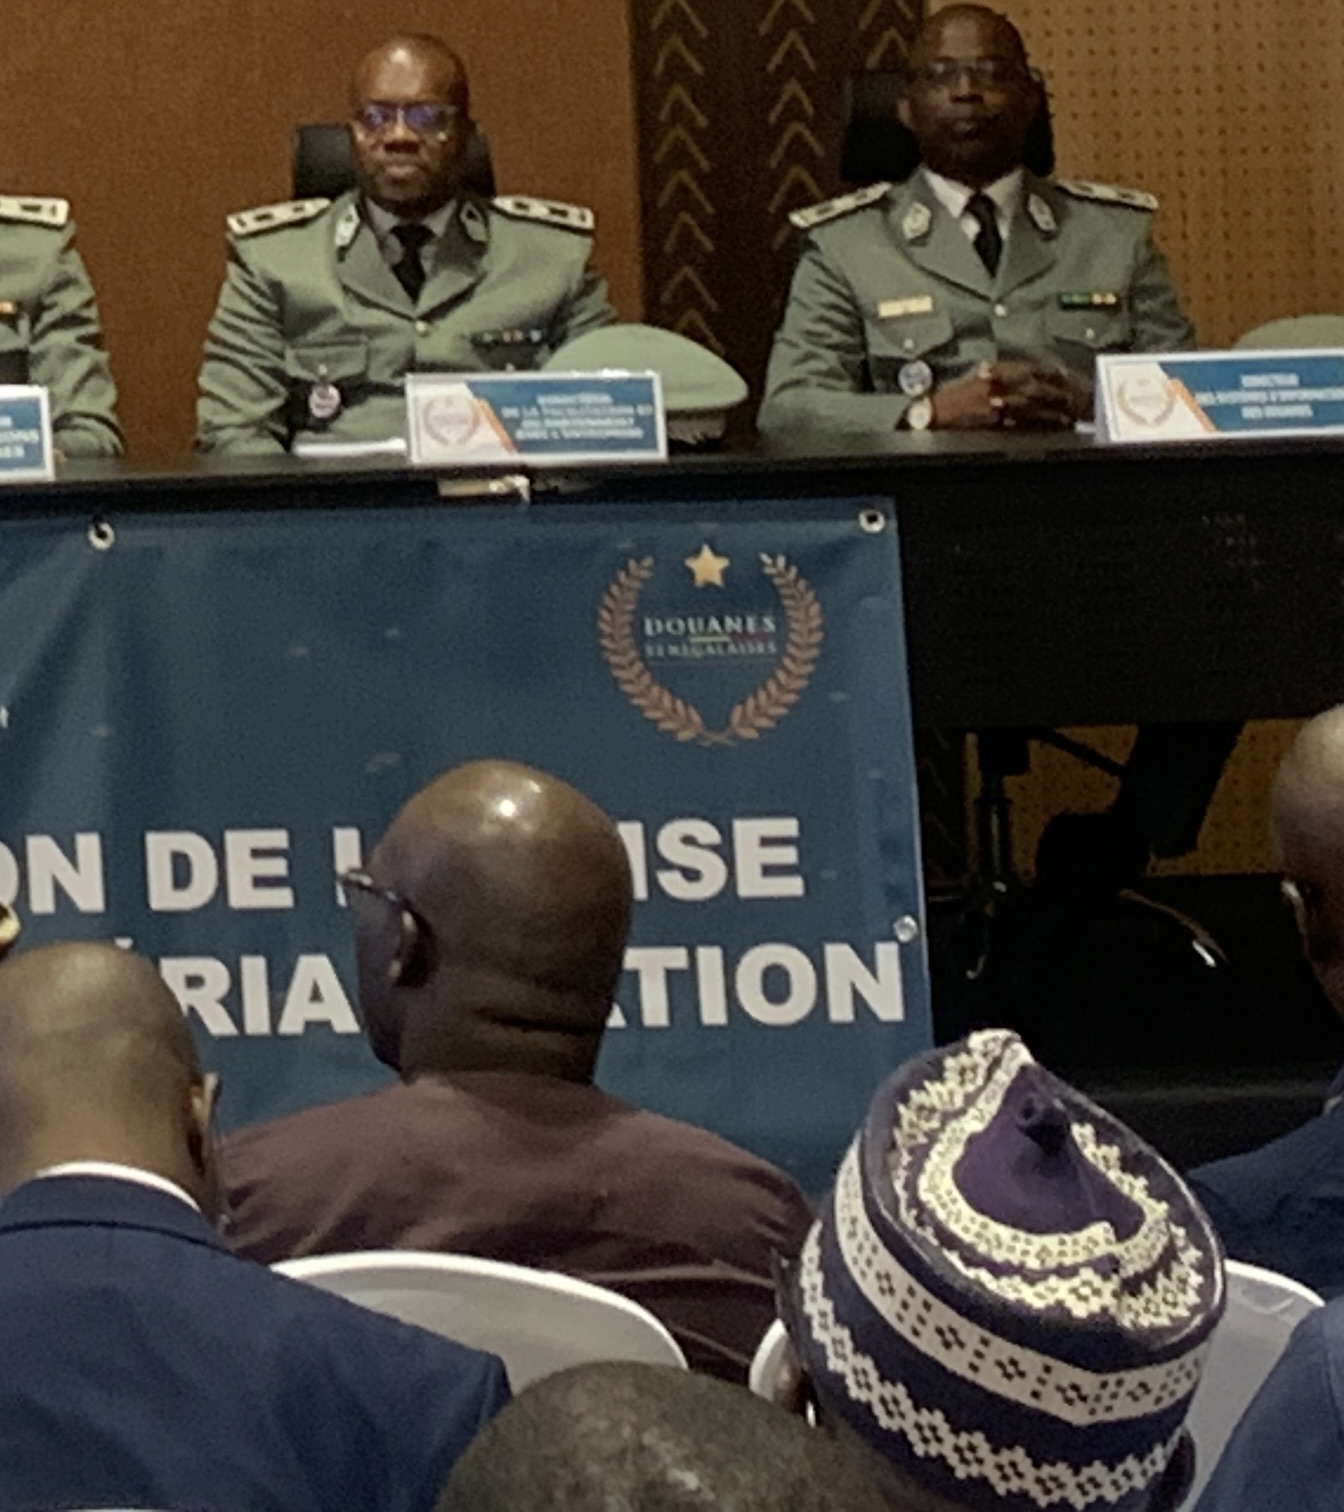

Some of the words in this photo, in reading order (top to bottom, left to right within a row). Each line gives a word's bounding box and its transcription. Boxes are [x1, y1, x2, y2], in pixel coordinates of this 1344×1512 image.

[643, 615, 777, 637] DOUANES
[145, 828, 295, 913] DE
[617, 817, 806, 902] ISE
